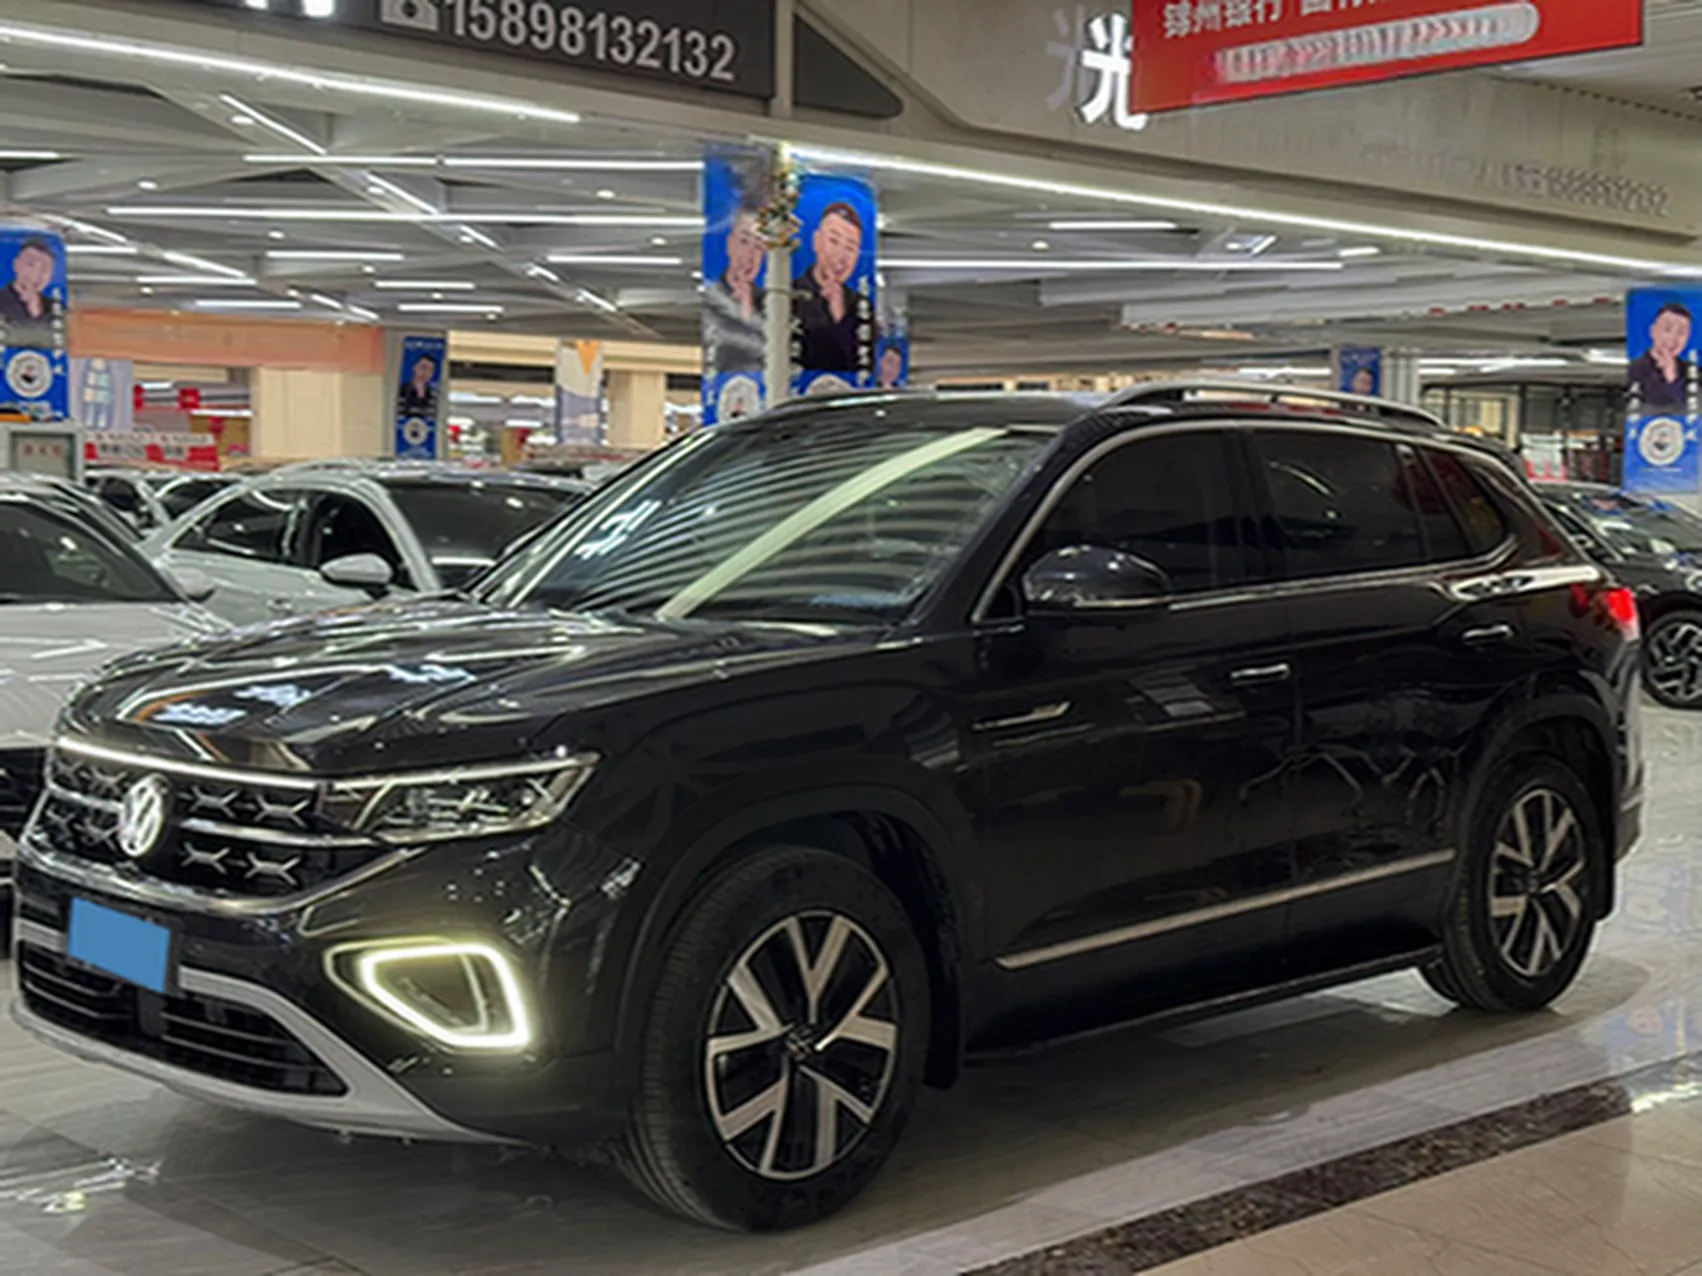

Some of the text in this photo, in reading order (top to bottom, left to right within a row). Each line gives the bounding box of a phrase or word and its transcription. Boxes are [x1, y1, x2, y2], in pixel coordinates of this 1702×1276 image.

[443, 0, 735, 81] 15898132132
[1163, 0, 1282, 38] 州银行
[1081, 12, 1148, 130] 光
